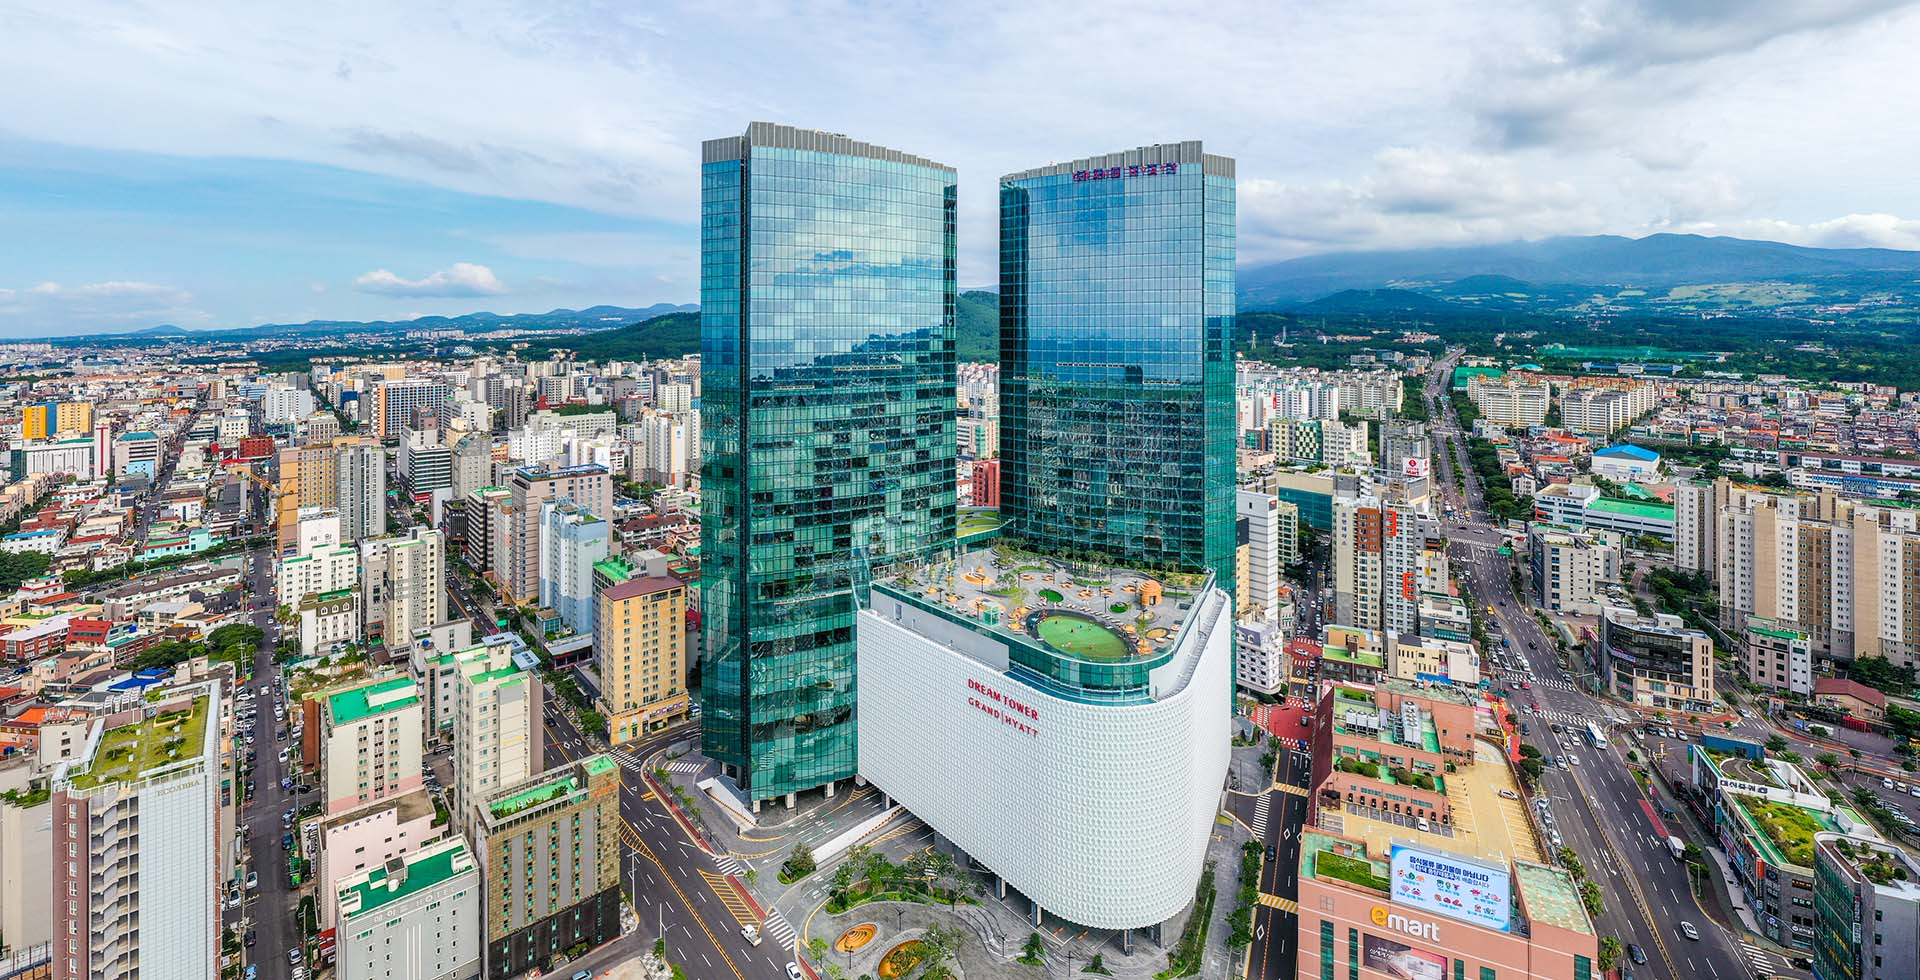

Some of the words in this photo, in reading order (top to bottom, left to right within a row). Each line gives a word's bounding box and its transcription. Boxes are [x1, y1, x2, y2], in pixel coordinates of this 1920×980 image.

[968, 678, 1001, 702] DREAM
[1003, 695, 1038, 721] TOWER
[968, 697, 1000, 719] GRAND
[1005, 715, 1038, 738] HYATT
[1371, 905, 1440, 942] emart
